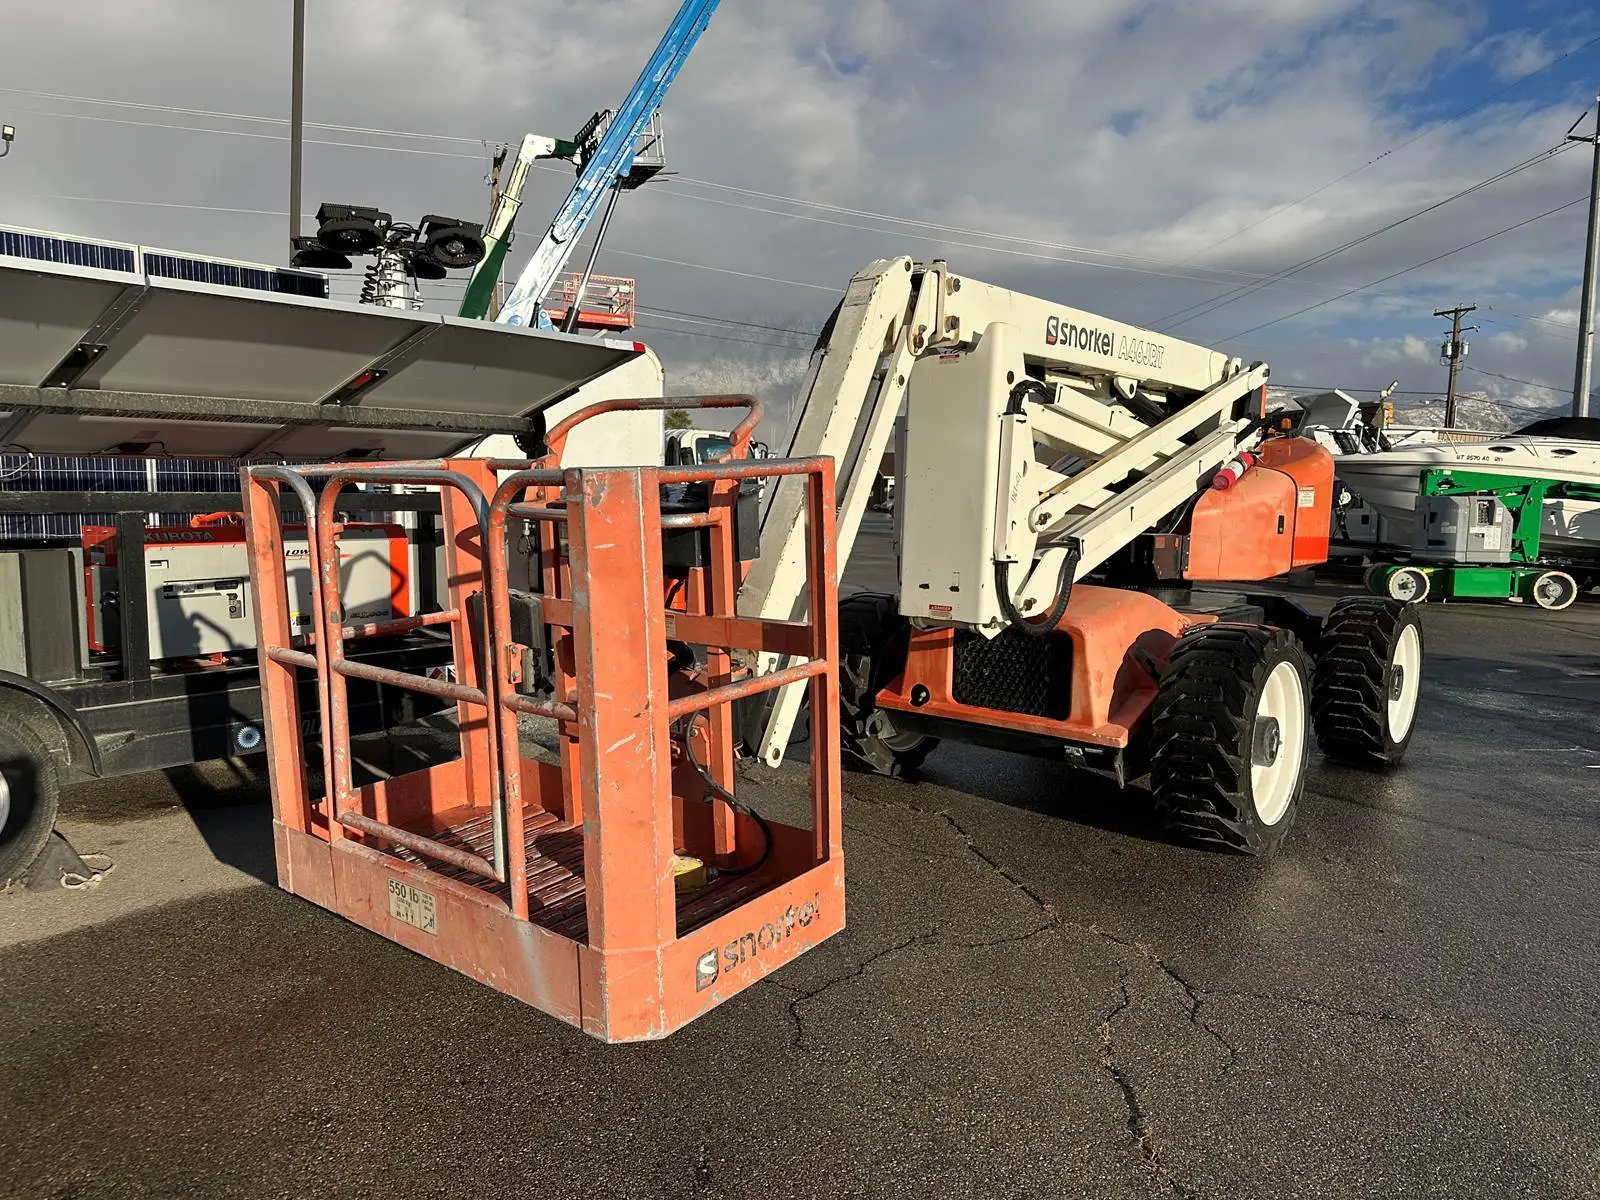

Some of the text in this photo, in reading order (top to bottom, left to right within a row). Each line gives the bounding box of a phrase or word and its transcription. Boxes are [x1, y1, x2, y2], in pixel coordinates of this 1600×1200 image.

[1060, 322, 1166, 369] snorkel A46JRT
[143, 531, 215, 542] KUBOTA
[389, 880, 406, 899] 550
[409, 887, 419, 904] lb
